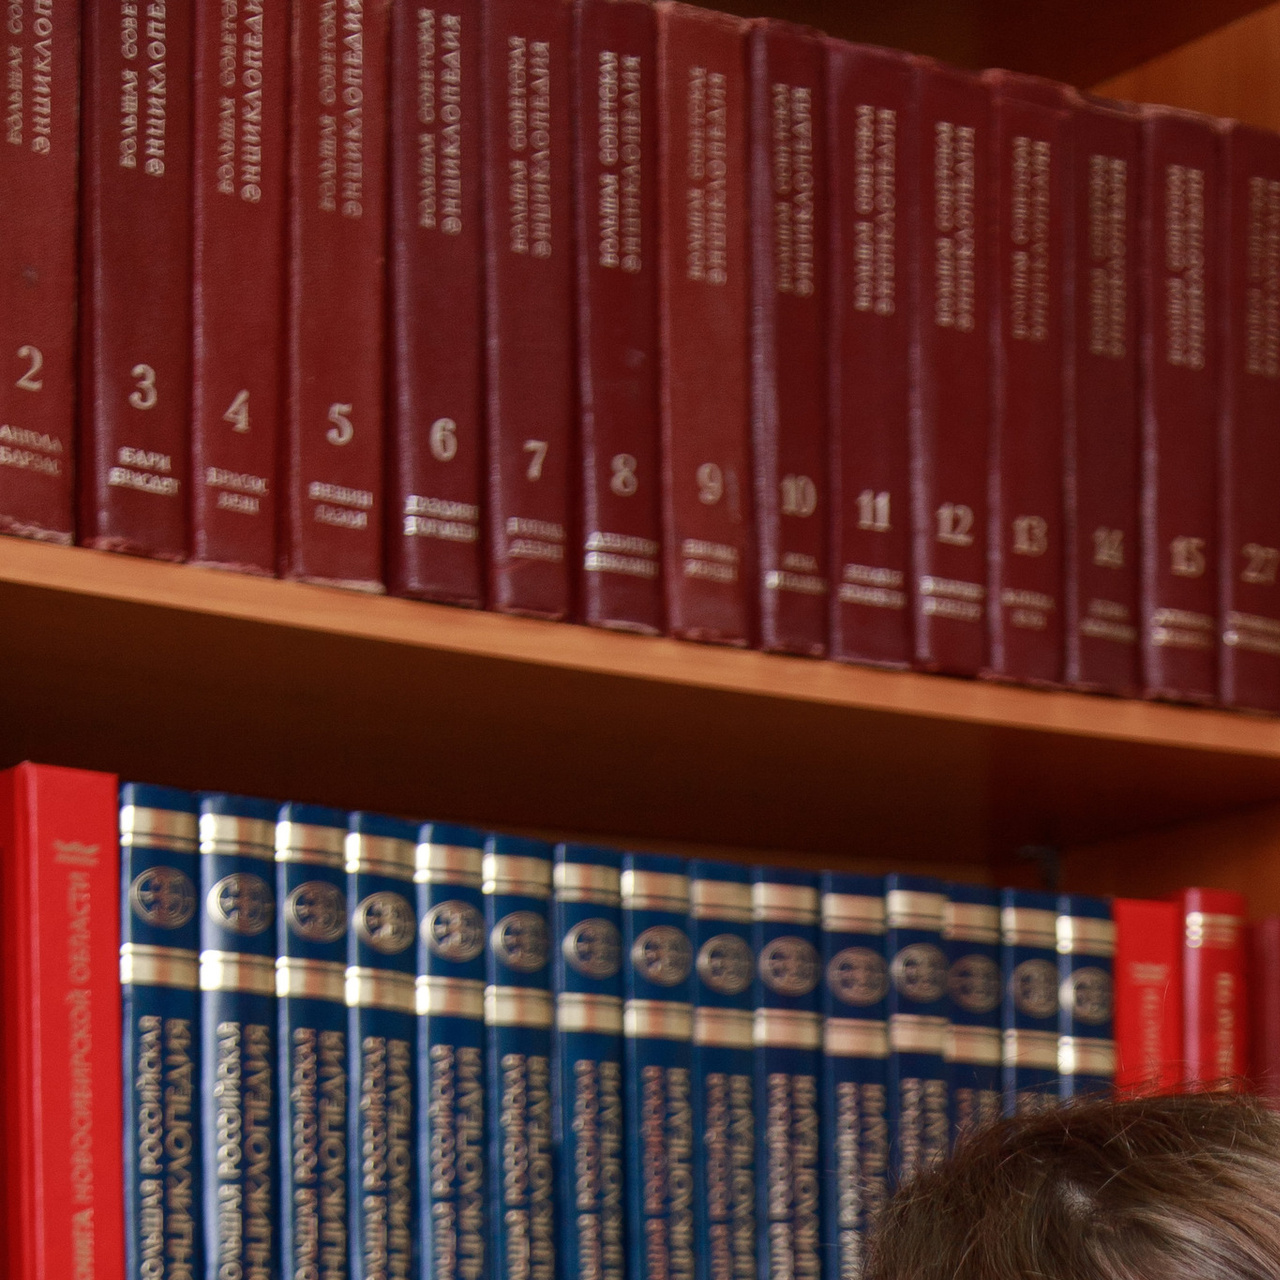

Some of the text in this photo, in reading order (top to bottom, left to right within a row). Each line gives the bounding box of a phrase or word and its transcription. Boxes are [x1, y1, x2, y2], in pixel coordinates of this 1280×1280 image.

[17, 346, 43, 391] 2
[131, 364, 158, 410] 3
[223, 390, 250, 433] 4
[327, 404, 354, 446] 5
[430, 417, 458, 461] 6
[523, 441, 548, 481] 7
[610, 454, 638, 496] 8
[697, 463, 724, 504] 9
[780, 474, 817, 517] 10
[857, 490, 892, 531] 11
[936, 505, 974, 546] 12
[1013, 516, 1048, 556] 13
[1169, 536, 1206, 578] 15
